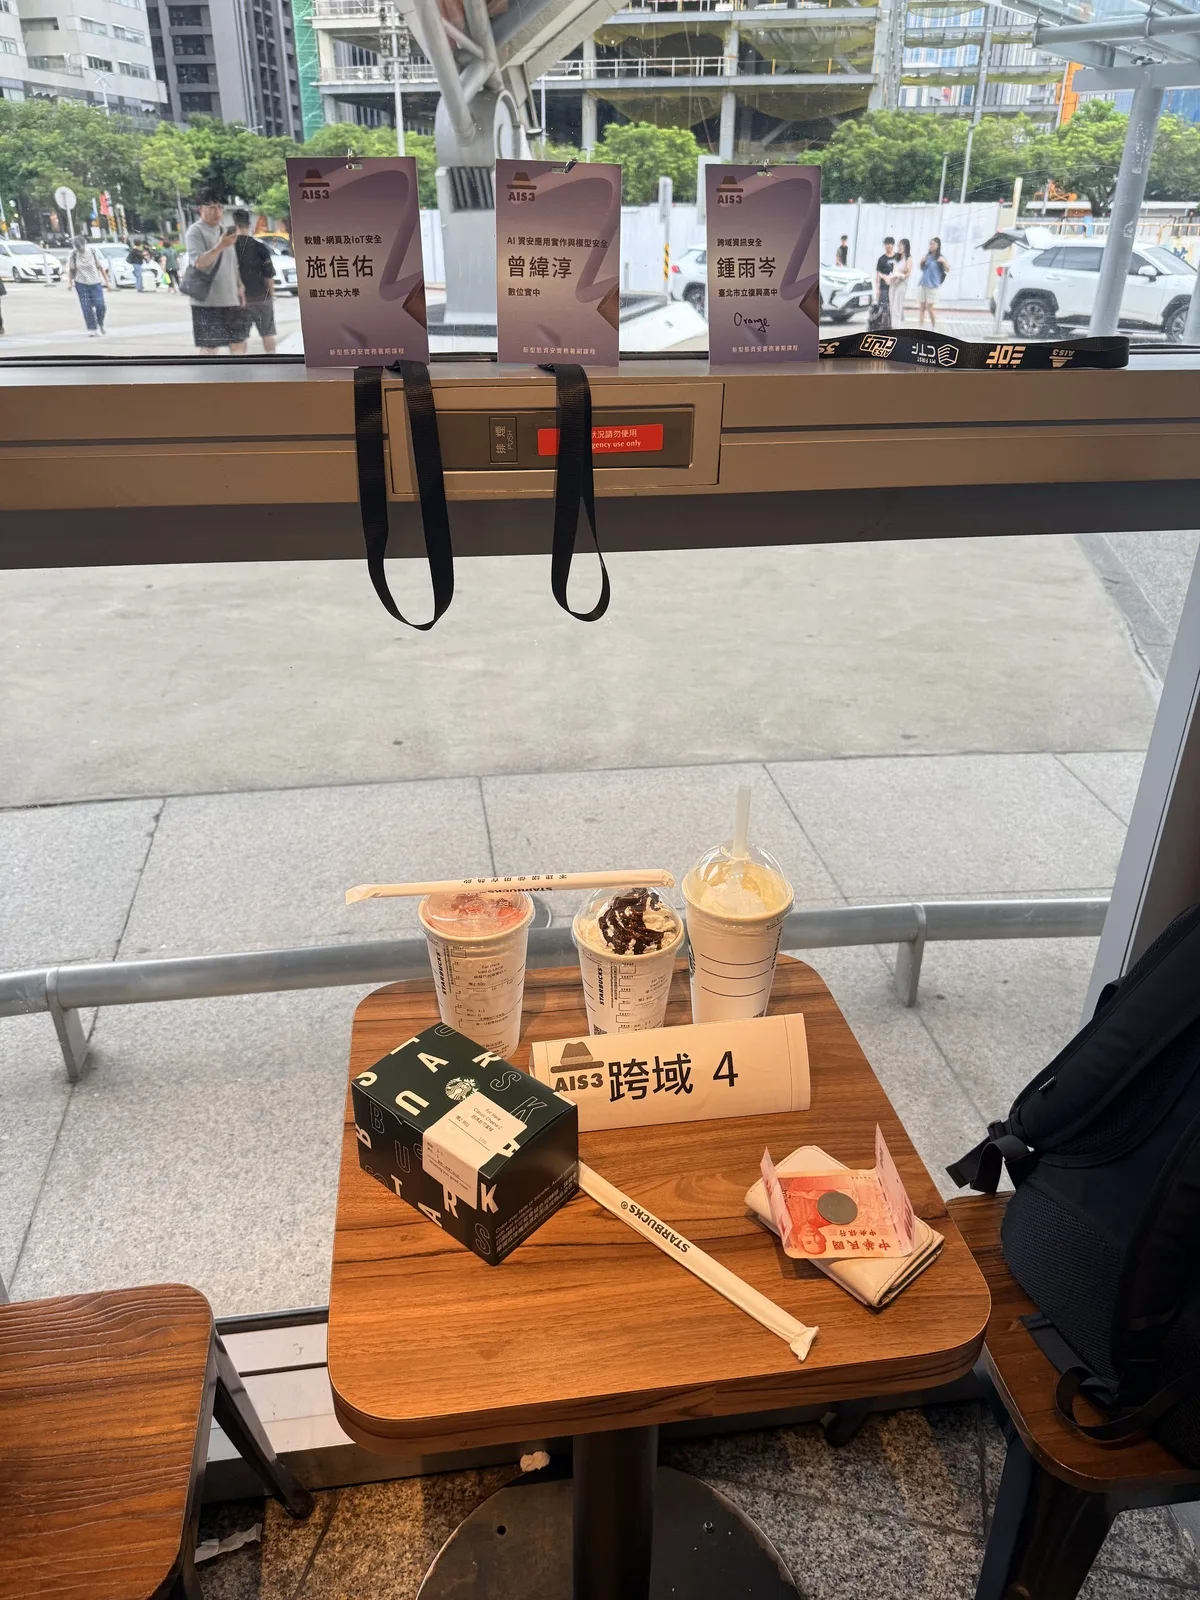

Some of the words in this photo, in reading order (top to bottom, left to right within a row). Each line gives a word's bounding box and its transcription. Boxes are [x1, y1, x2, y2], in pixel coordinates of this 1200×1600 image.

[301, 189, 330, 200] AIS3
[508, 191, 536, 202] AIS3
[717, 194, 743, 205] AIS3
[716, 238, 763, 247] 跨域資訊安全
[305, 254, 374, 278] 施信佑
[508, 256, 572, 279] 曾緯淳
[716, 256, 777, 279] 鍾雨岑
[309, 288, 360, 298] 國立中央大學
[717, 287, 778, 298] 臺北市立復興高中
[733, 312, 770, 333] Orange
[911, 342, 937, 356] CTF
[612, 441, 625, 449] use
[626, 439, 642, 449] only
[436, 949, 447, 995] STARBUCKS
[597, 965, 606, 1006] STARBUCKS
[555, 1072, 604, 1093] AIS3
[608, 1053, 694, 1103] 跨域
[712, 1050, 739, 1087] 4
[831, 1238, 891, 1252] 中華民國
